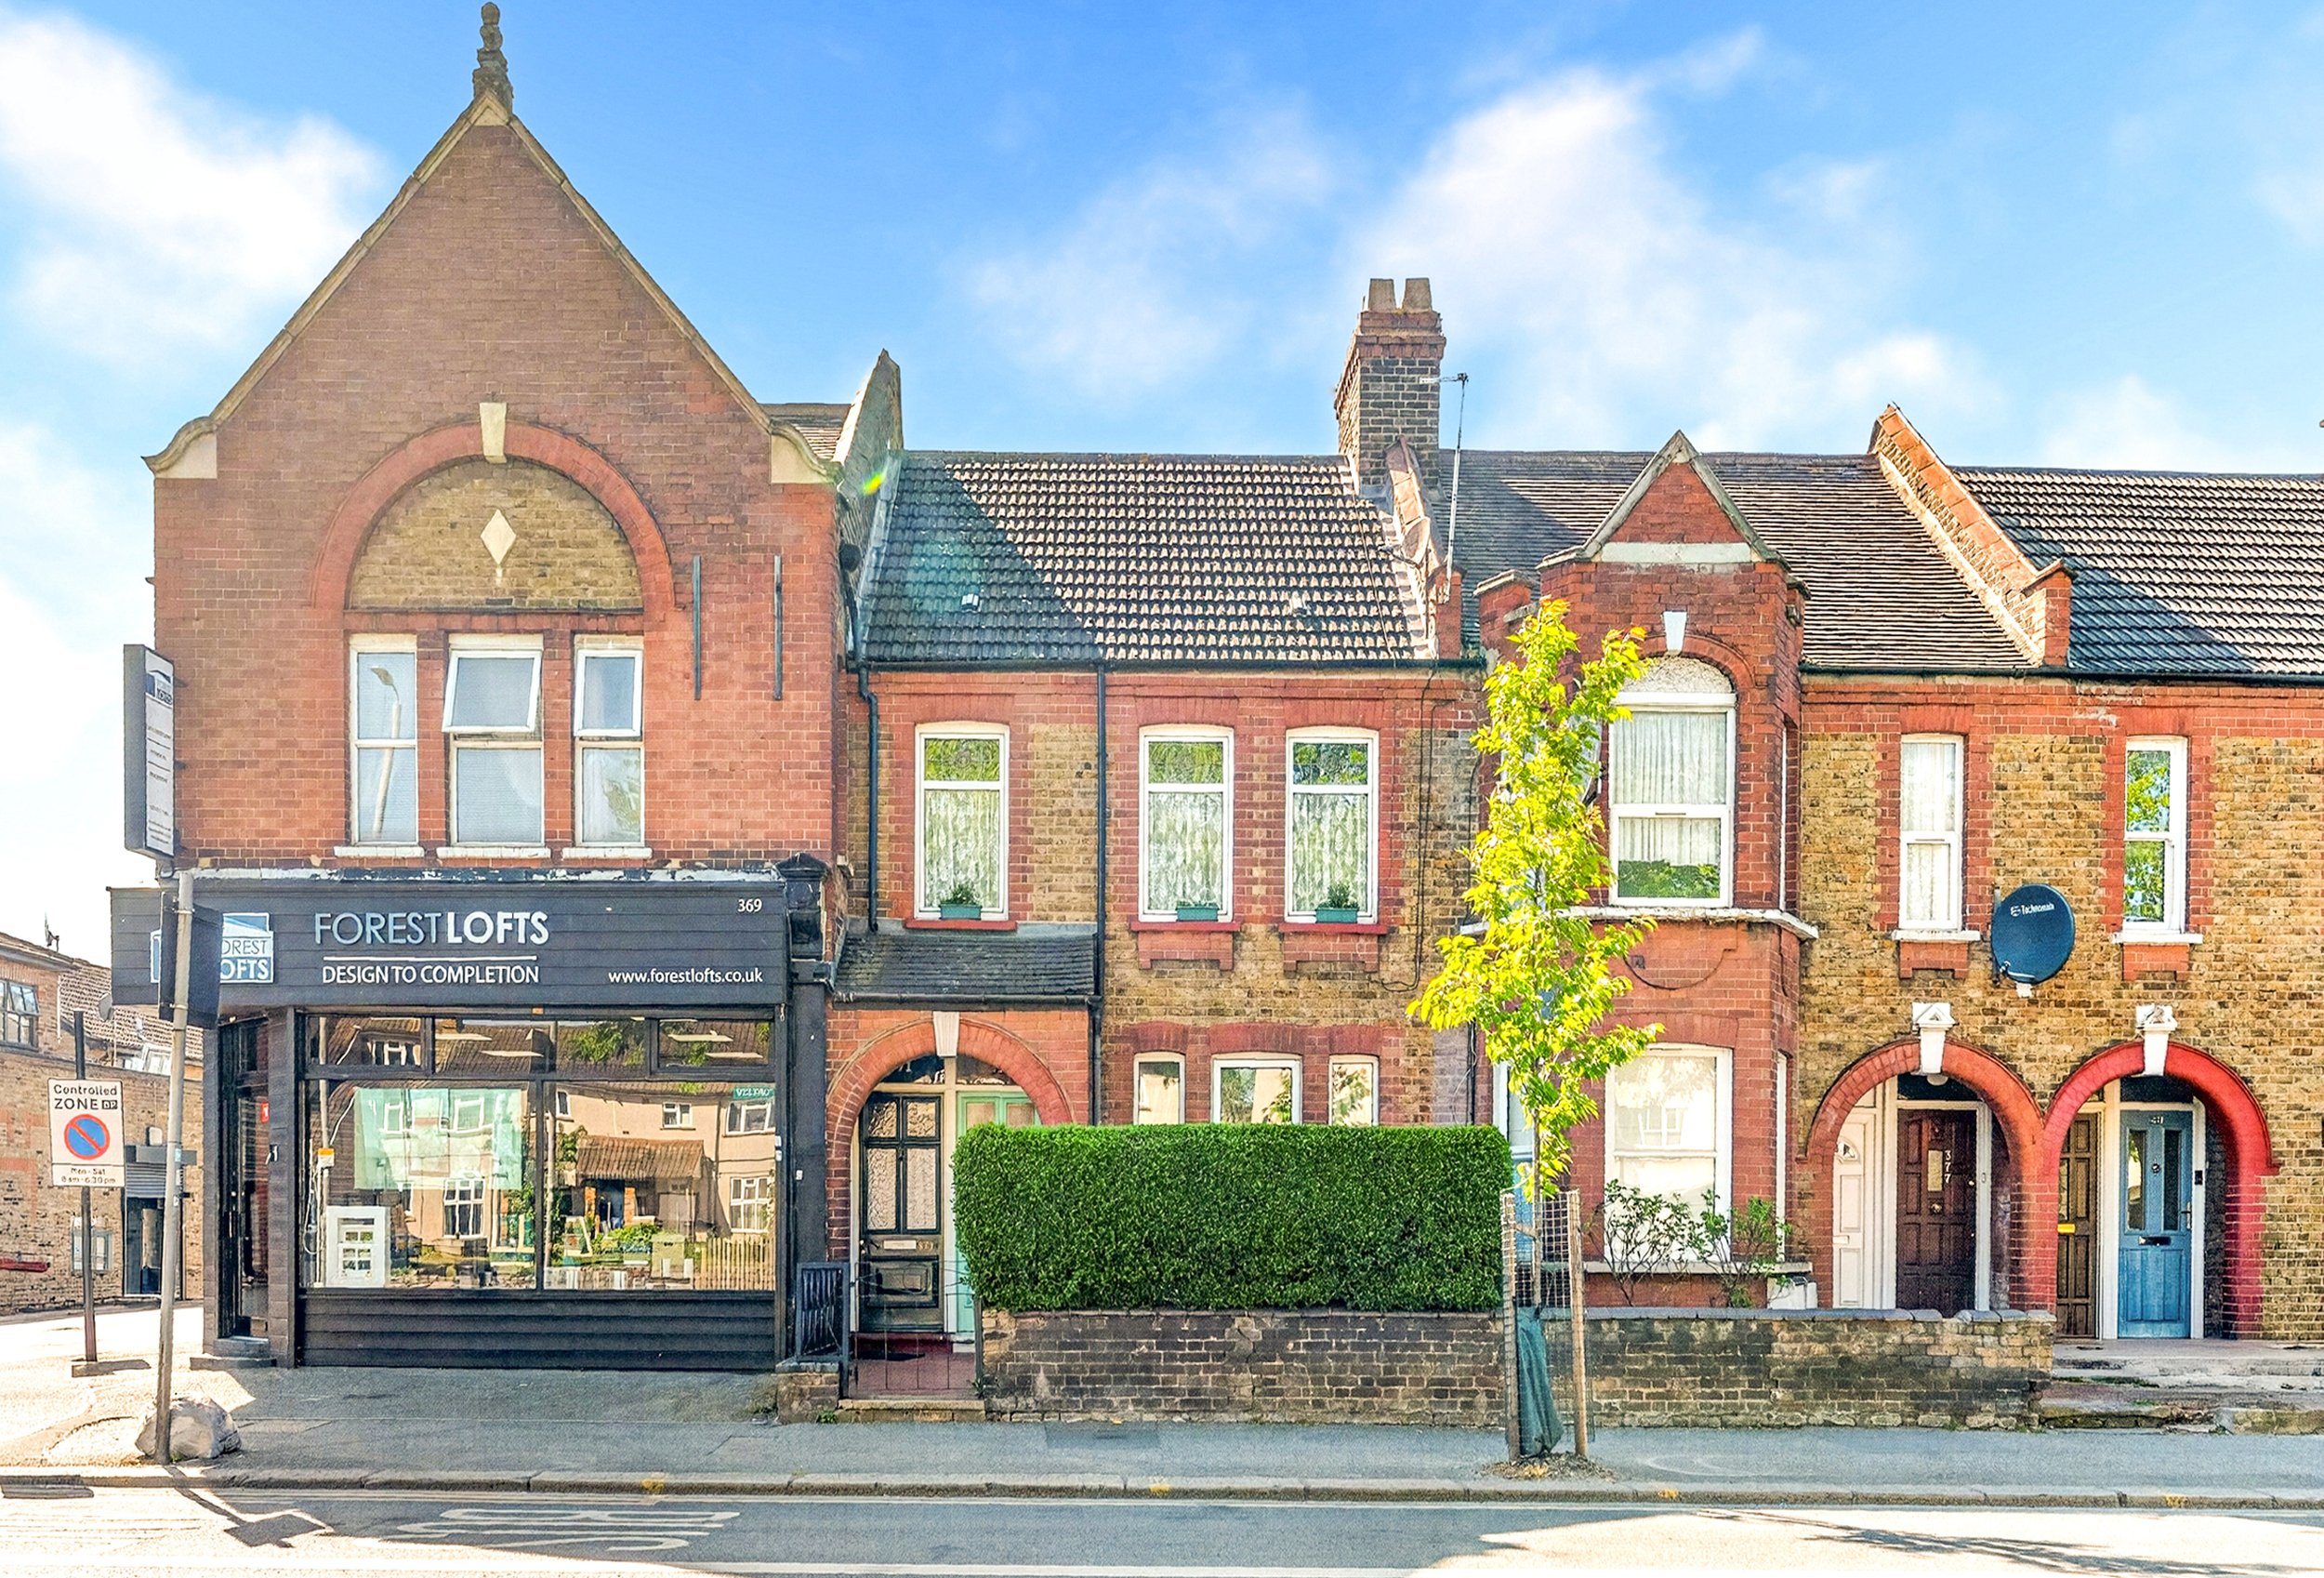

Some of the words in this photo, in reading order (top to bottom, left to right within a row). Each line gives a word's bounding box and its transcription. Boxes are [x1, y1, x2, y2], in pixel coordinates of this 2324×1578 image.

[737, 898, 762, 913] 369
[314, 911, 442, 945] FOREST
[446, 910, 550, 945] LOFTS
[222, 939, 269, 955] OREST
[219, 959, 270, 980] OFTS
[323, 965, 389, 984] DESIGN
[391, 965, 416, 984] TO
[420, 965, 539, 984] COMPLETION
[608, 967, 763, 984] www.forestlofts.co.uk
[53, 1083, 117, 1095] Controlled
[54, 1097, 99, 1110] ZONE
